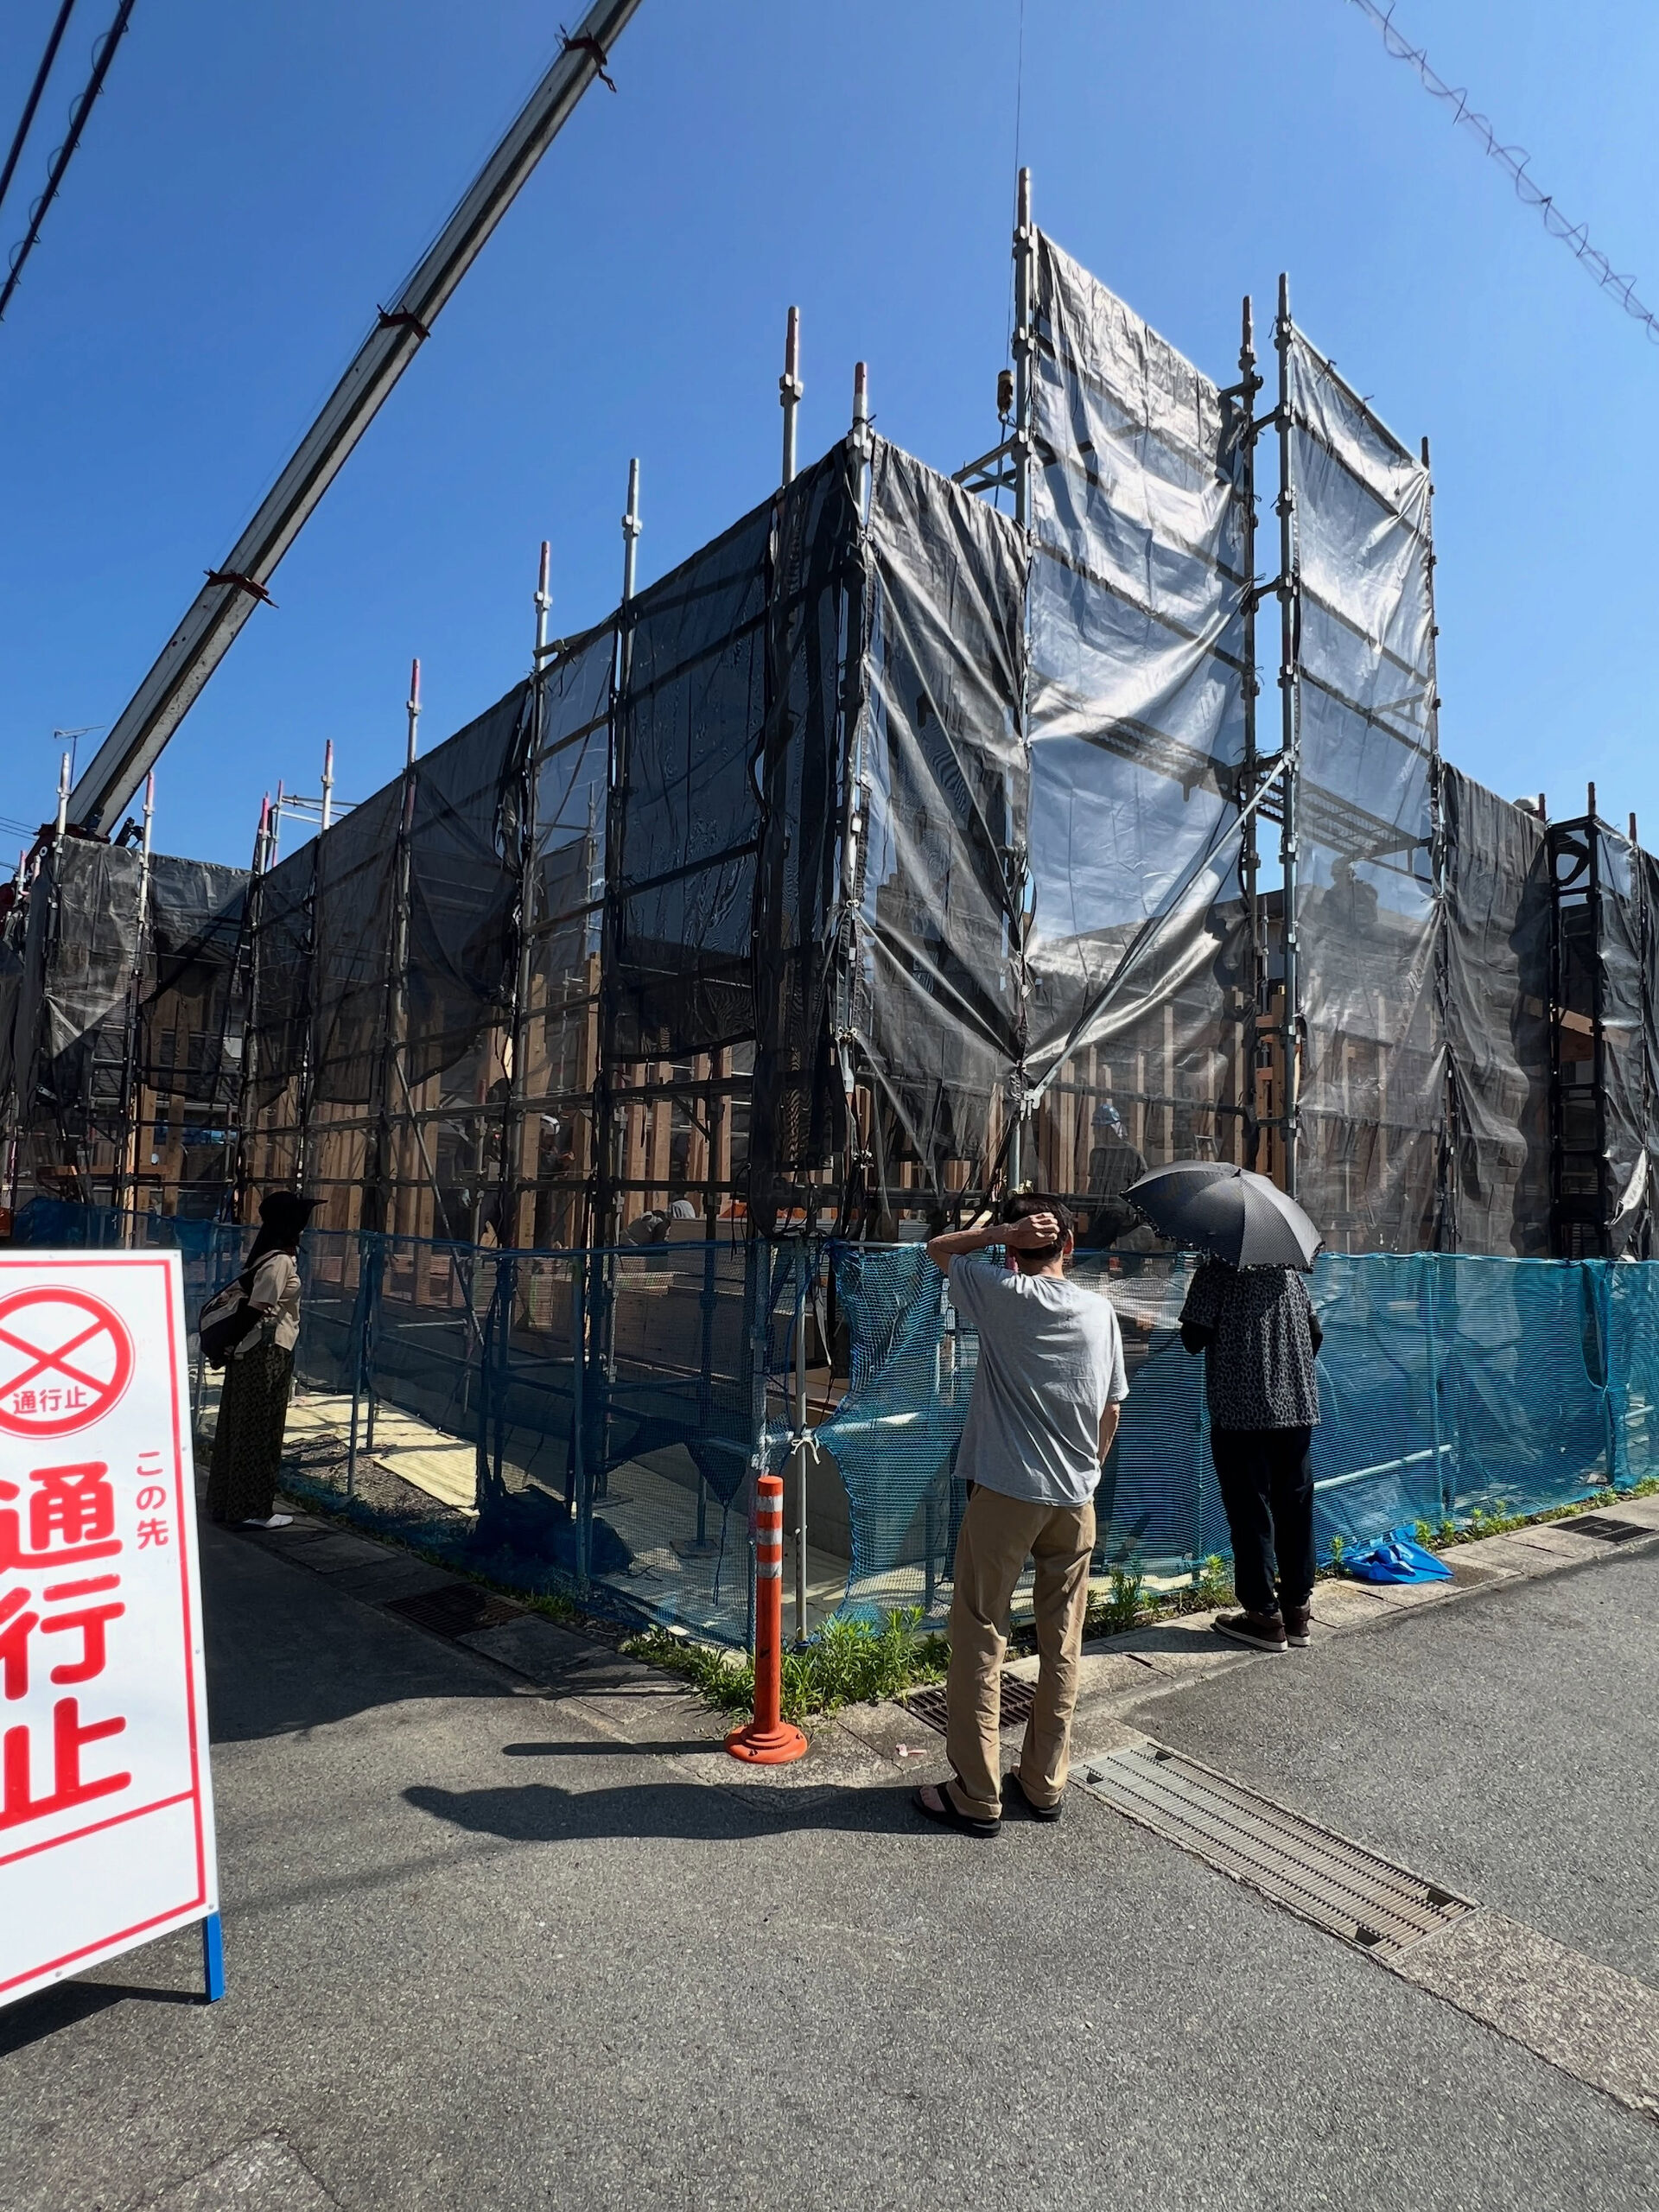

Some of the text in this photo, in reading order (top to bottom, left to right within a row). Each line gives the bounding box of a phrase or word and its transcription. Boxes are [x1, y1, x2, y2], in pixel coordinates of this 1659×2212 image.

[13, 1386, 88, 1414] 通行止
[136, 1452, 169, 1549] この先
